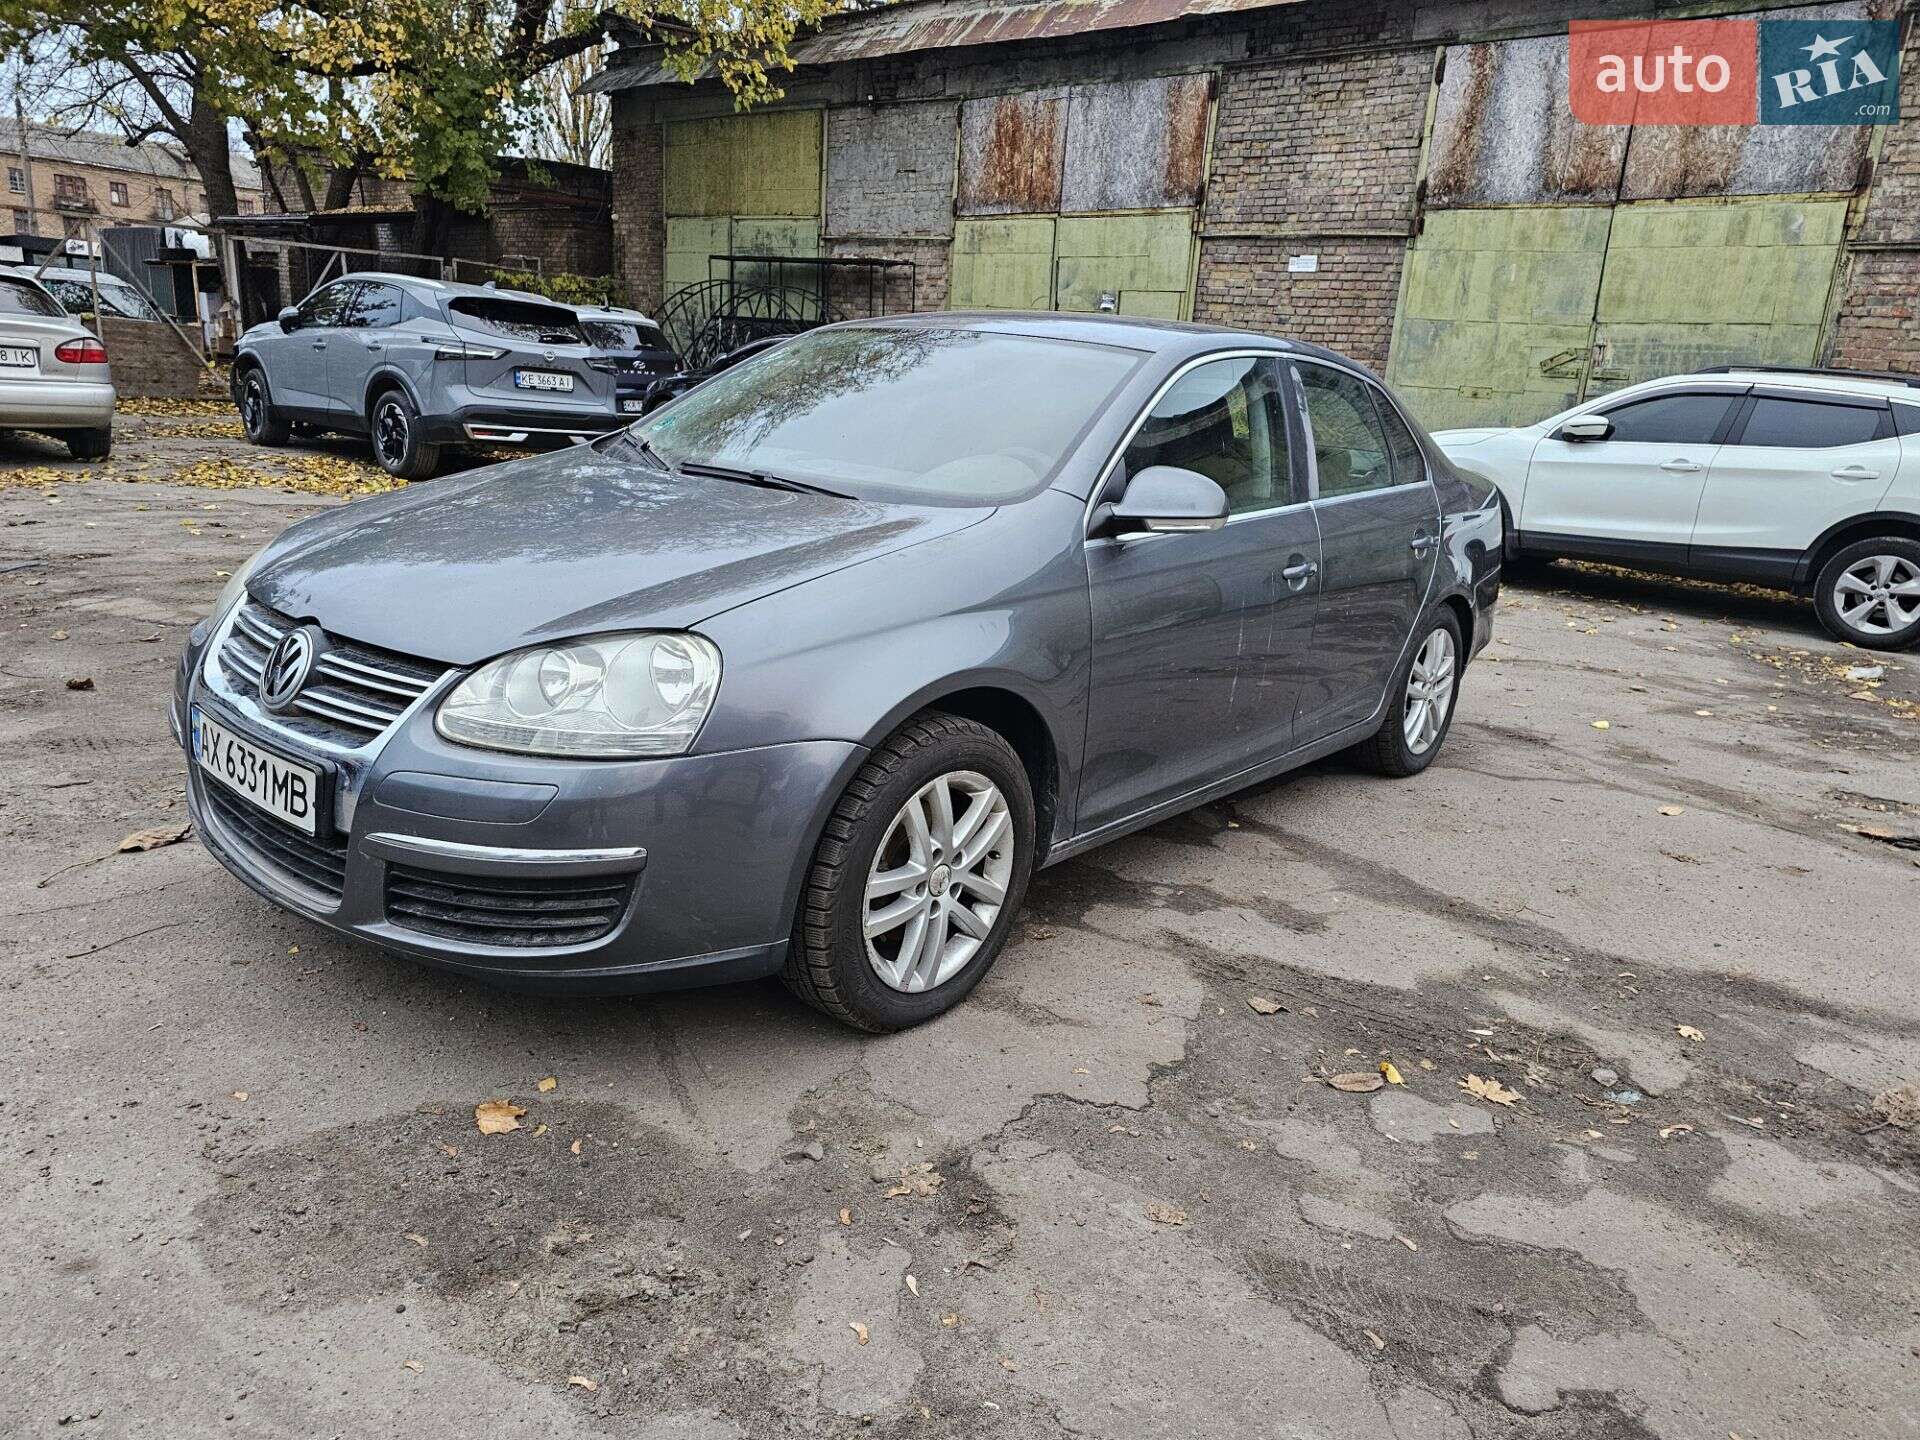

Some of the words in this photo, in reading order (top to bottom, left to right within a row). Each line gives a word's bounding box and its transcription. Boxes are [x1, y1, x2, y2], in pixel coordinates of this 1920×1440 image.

[521, 374, 535, 385] KE
[537, 375, 557, 386] 3663
[201, 722, 221, 772] AX
[226, 739, 268, 801] 6331
[272, 764, 308, 819] MB
